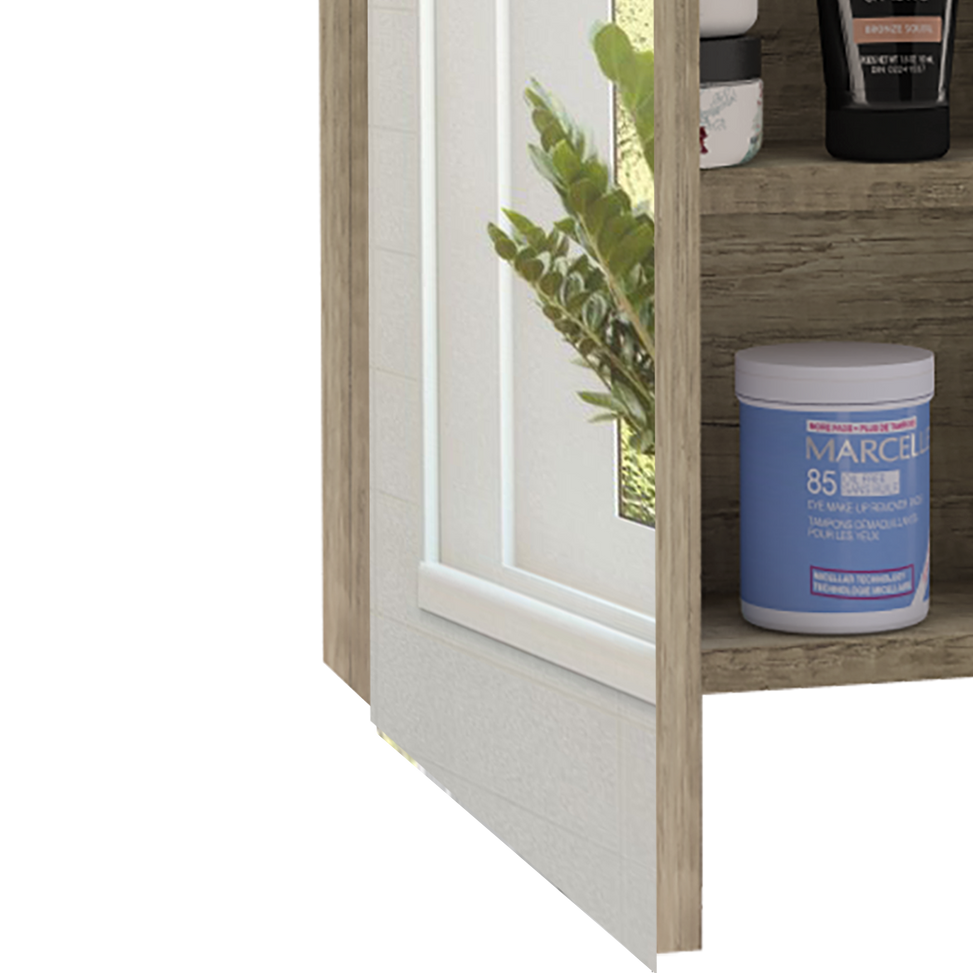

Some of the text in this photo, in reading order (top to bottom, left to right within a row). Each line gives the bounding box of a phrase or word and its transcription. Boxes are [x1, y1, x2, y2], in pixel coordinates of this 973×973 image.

[807, 468, 837, 496] 85
[807, 499, 825, 511] EYE
[807, 528, 880, 541] POUR LES YEUX
